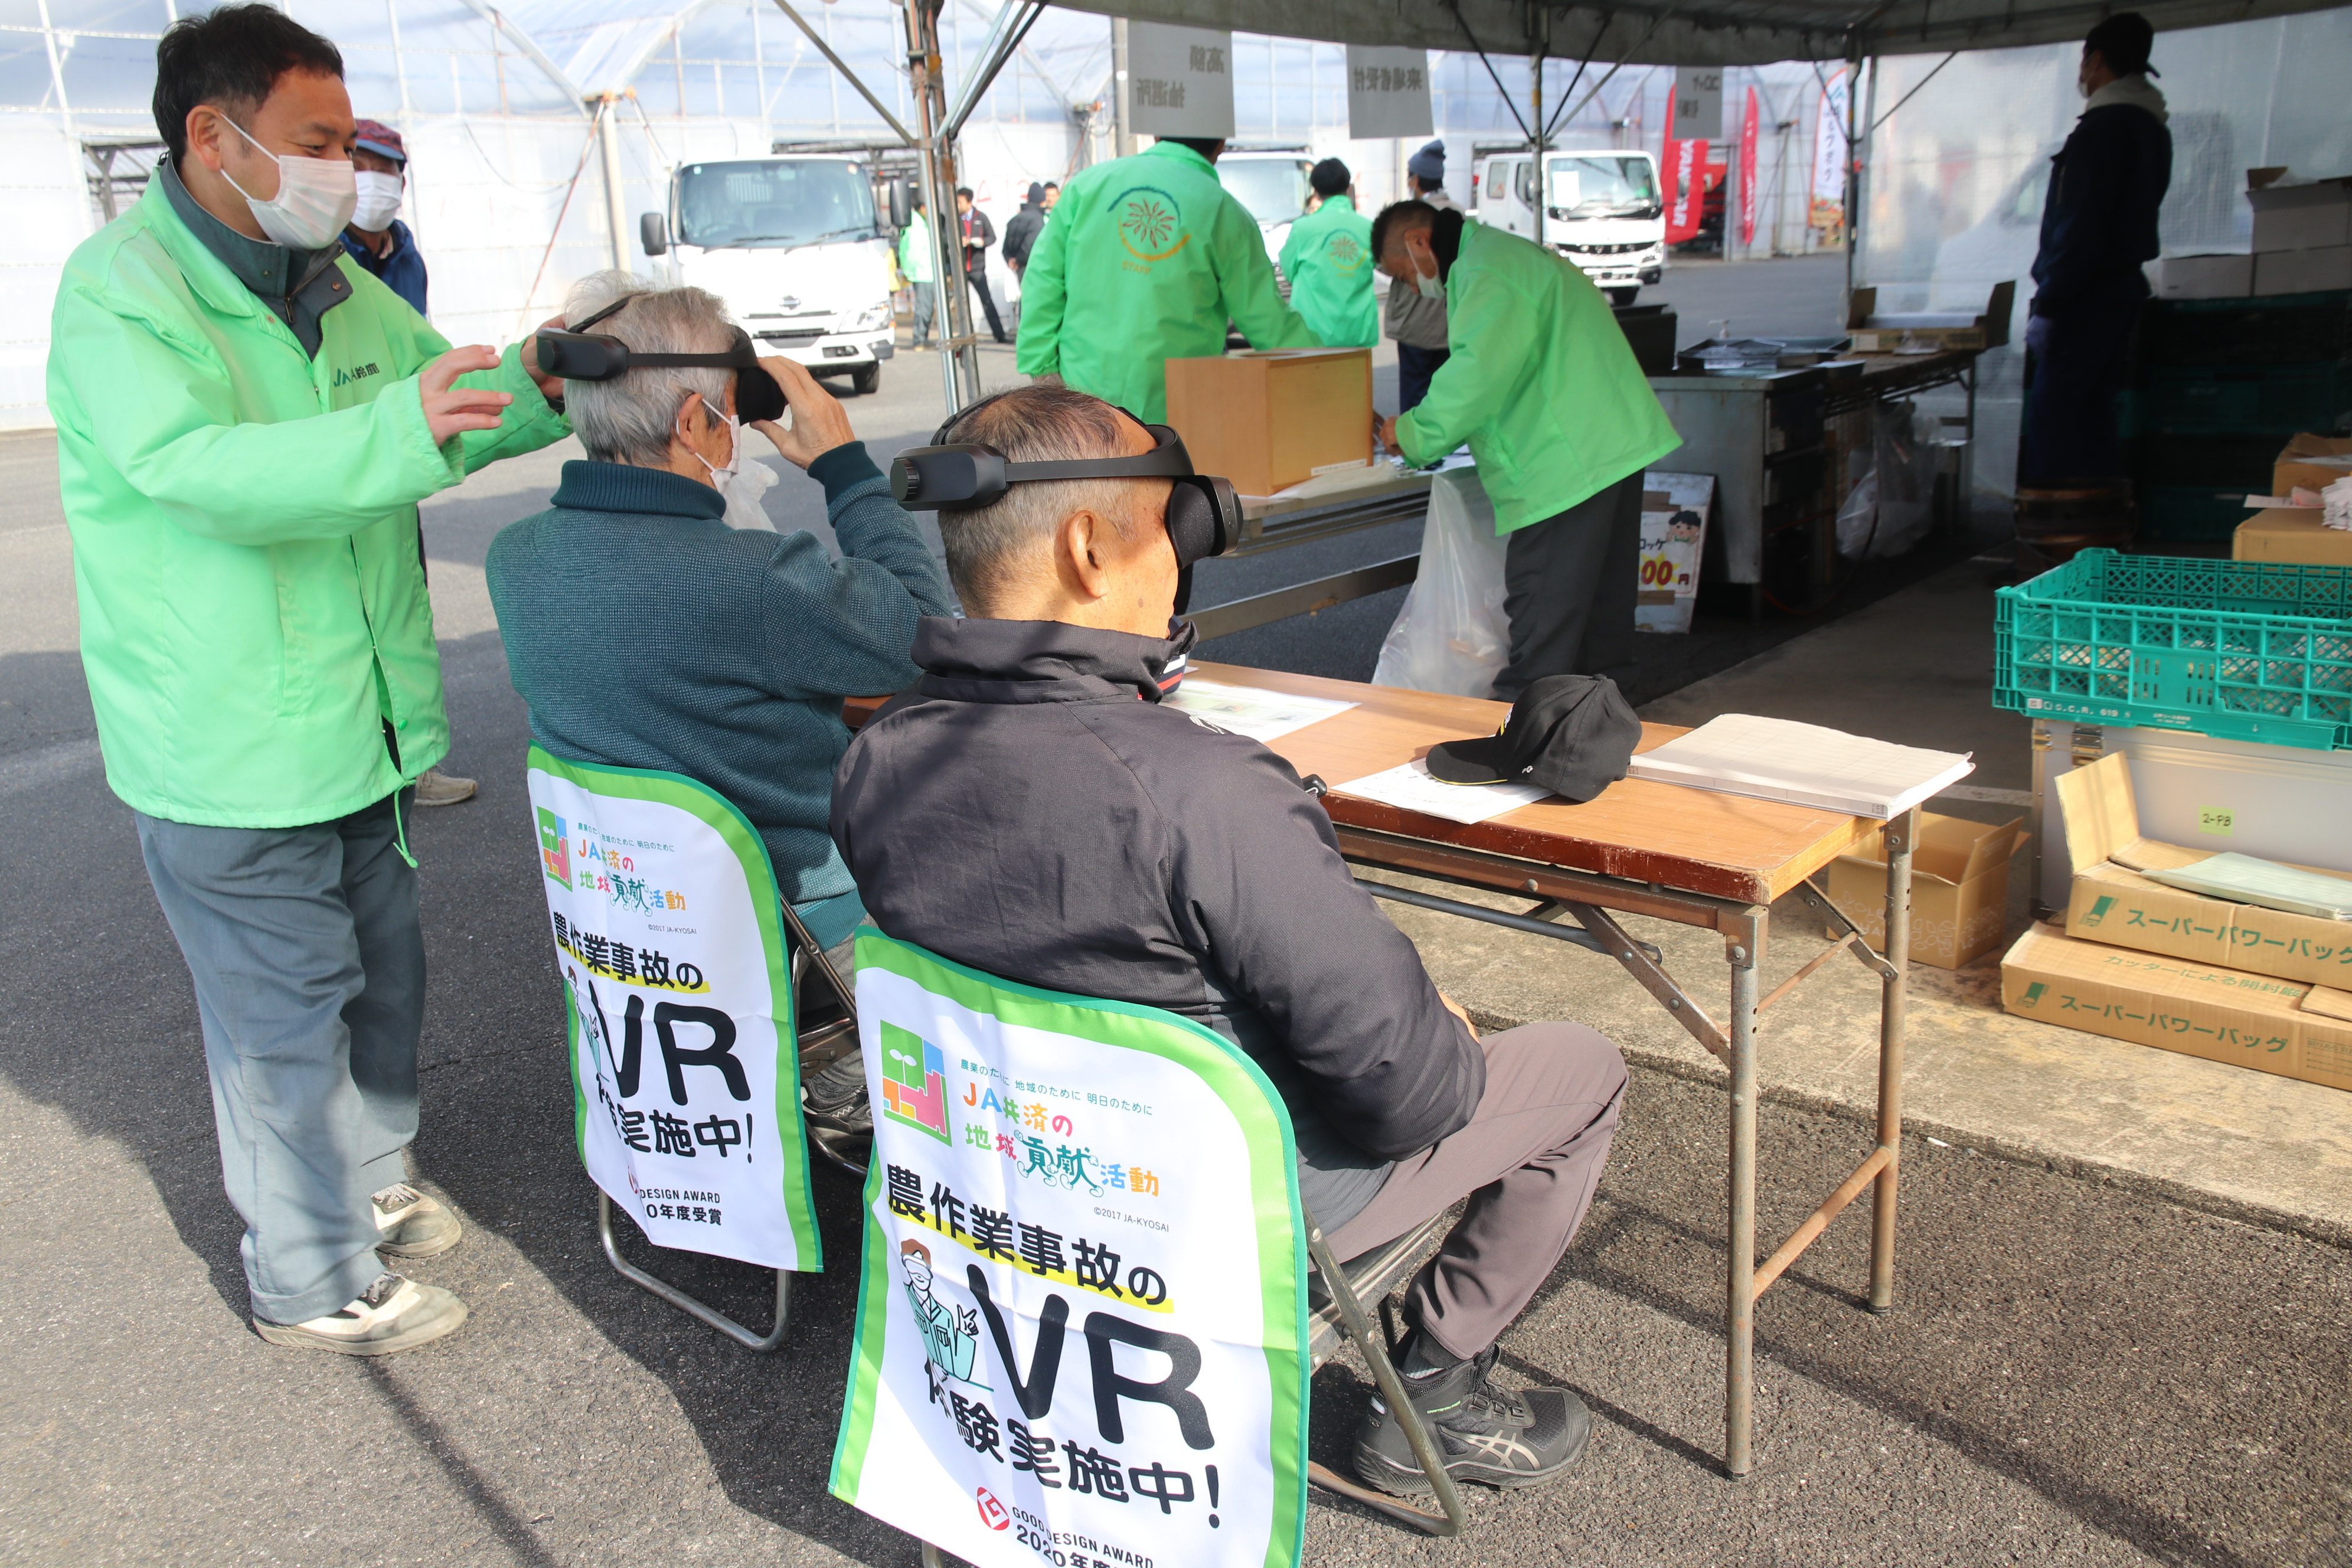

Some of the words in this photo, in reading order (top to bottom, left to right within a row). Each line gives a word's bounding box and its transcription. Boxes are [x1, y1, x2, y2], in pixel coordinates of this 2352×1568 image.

[1672, 139, 1696, 228] YANAR
[602, 834, 635, 847] 地域のために
[637, 840, 675, 852] 明日のために
[553, 912, 703, 989] 農作業事故の
[667, 926, 697, 935] JA-KYOSAI
[589, 979, 752, 1106] VR
[2060, 995, 2289, 1053] スーパーパワーバッグ
[961, 1059, 1010, 1086] 農業のたに
[1015, 1079, 1081, 1100] 地域のために
[1087, 1093, 1152, 1116] 明日のために
[963, 1082, 1073, 1138] JA共済の
[965, 1123, 1159, 1197] 地域貢献活動
[640, 1188, 680, 1200] DESIGN
[684, 1191, 720, 1204] AWARD
[646, 1204, 721, 1226] 0年度受賞
[1094, 1207, 1121, 1221] ©2017
[1123, 1214, 1170, 1233] JA-KYOSAI
[887, 1164, 1167, 1305] 農作業事故の
[967, 1263, 1215, 1451] VR
[1012, 1507, 1045, 1533] GOOD
[1046, 1527, 1098, 1553] DESIGN
[1103, 1544, 1154, 1568] AWARD
